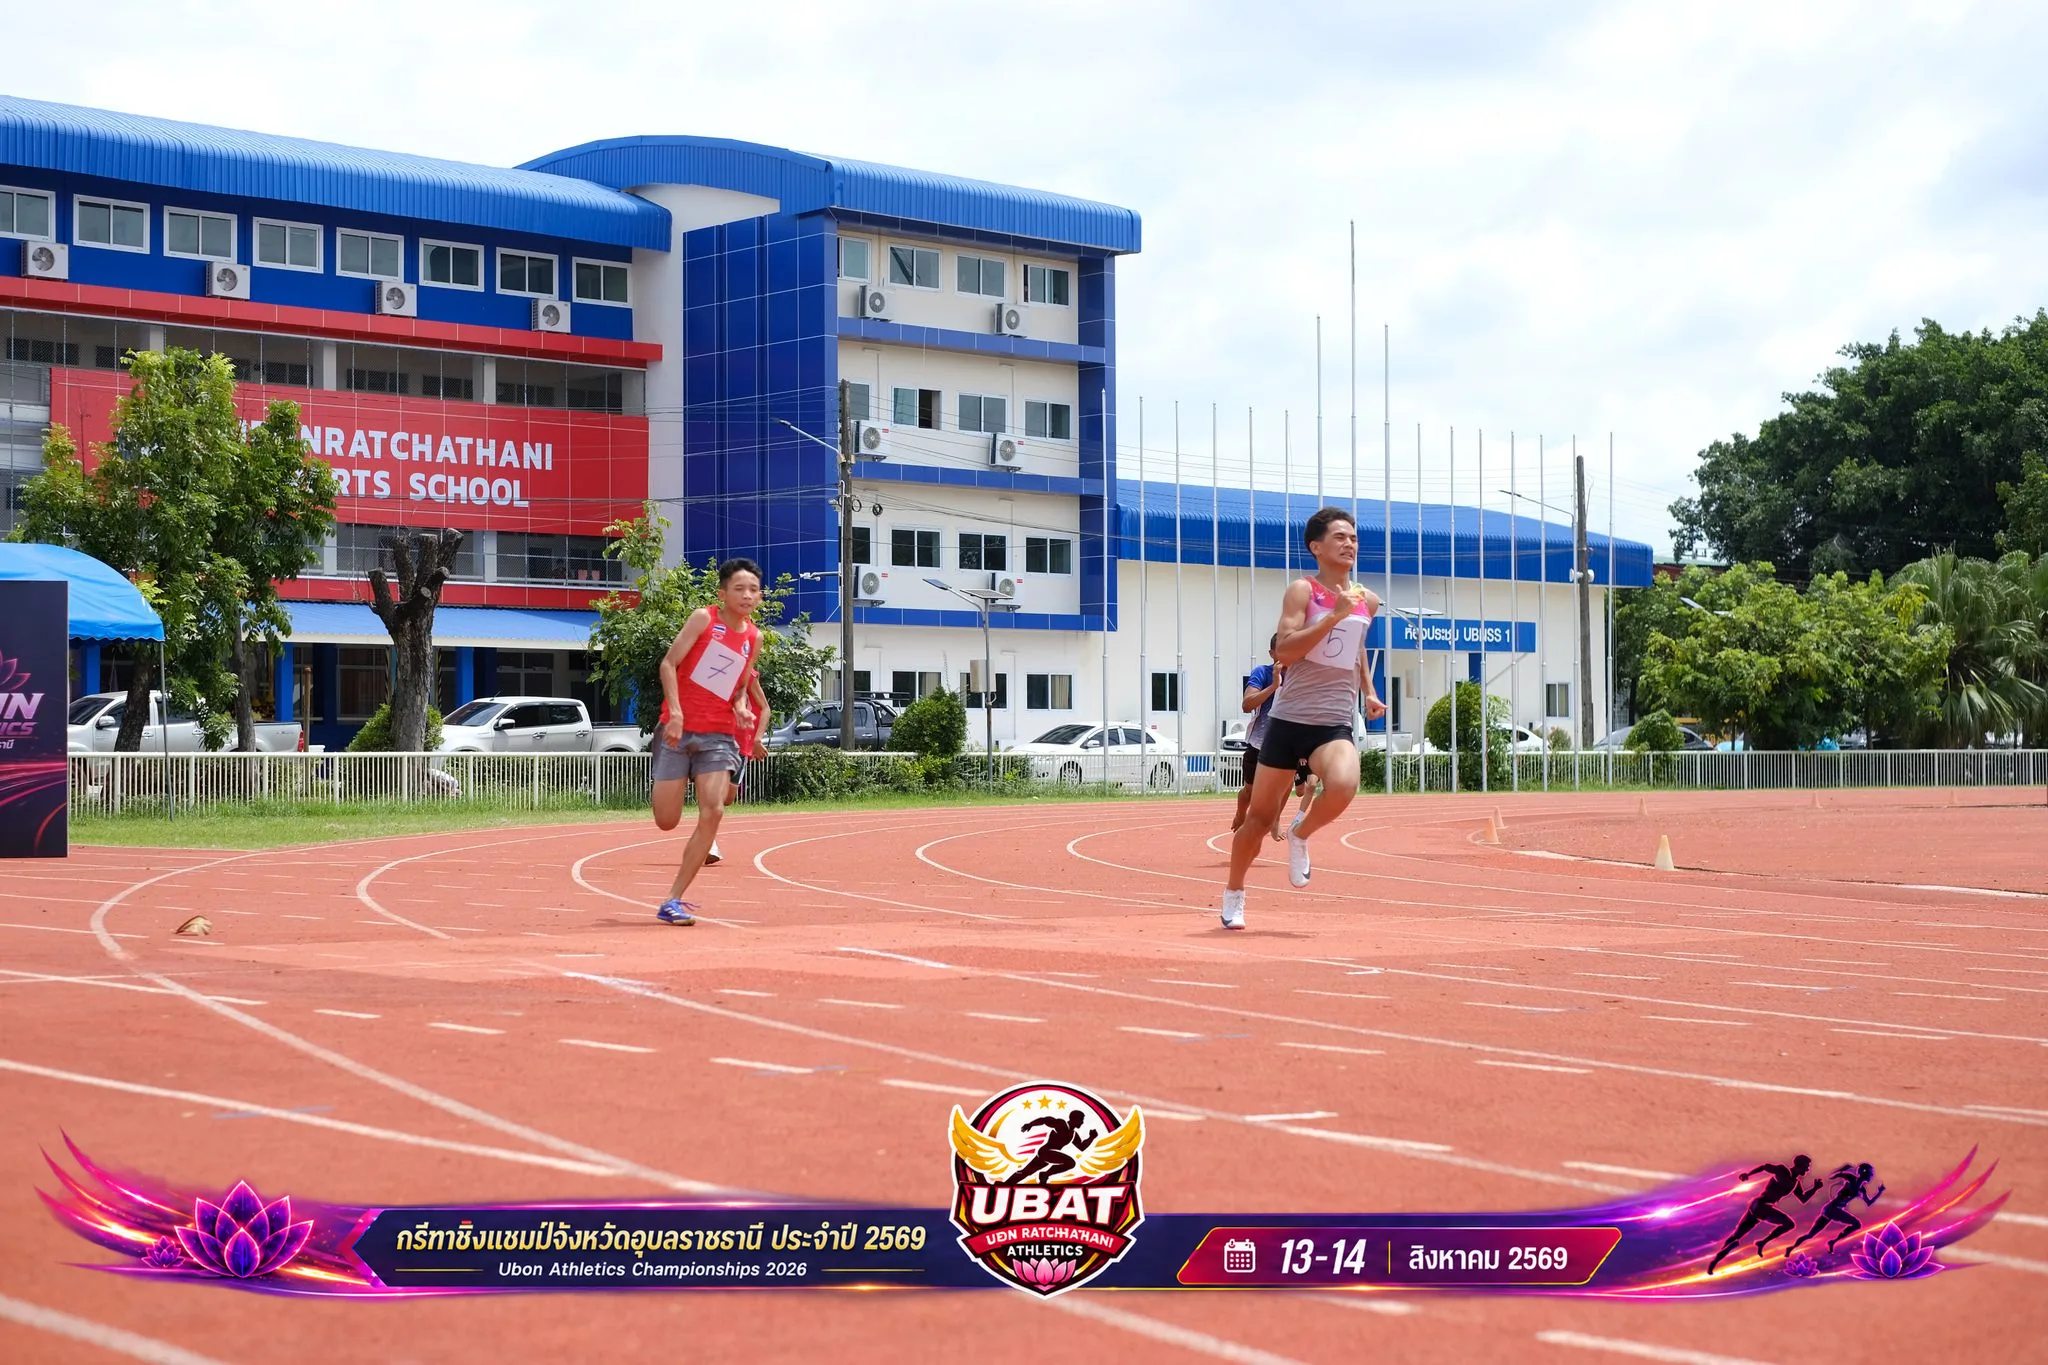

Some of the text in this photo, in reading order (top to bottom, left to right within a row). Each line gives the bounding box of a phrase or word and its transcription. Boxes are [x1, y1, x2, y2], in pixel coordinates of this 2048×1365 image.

[409, 472, 529, 508] SCHOOL
[1323, 627, 1347, 658] 5
[1505, 628, 1510, 643] 1
[708, 654, 735, 679] 7
